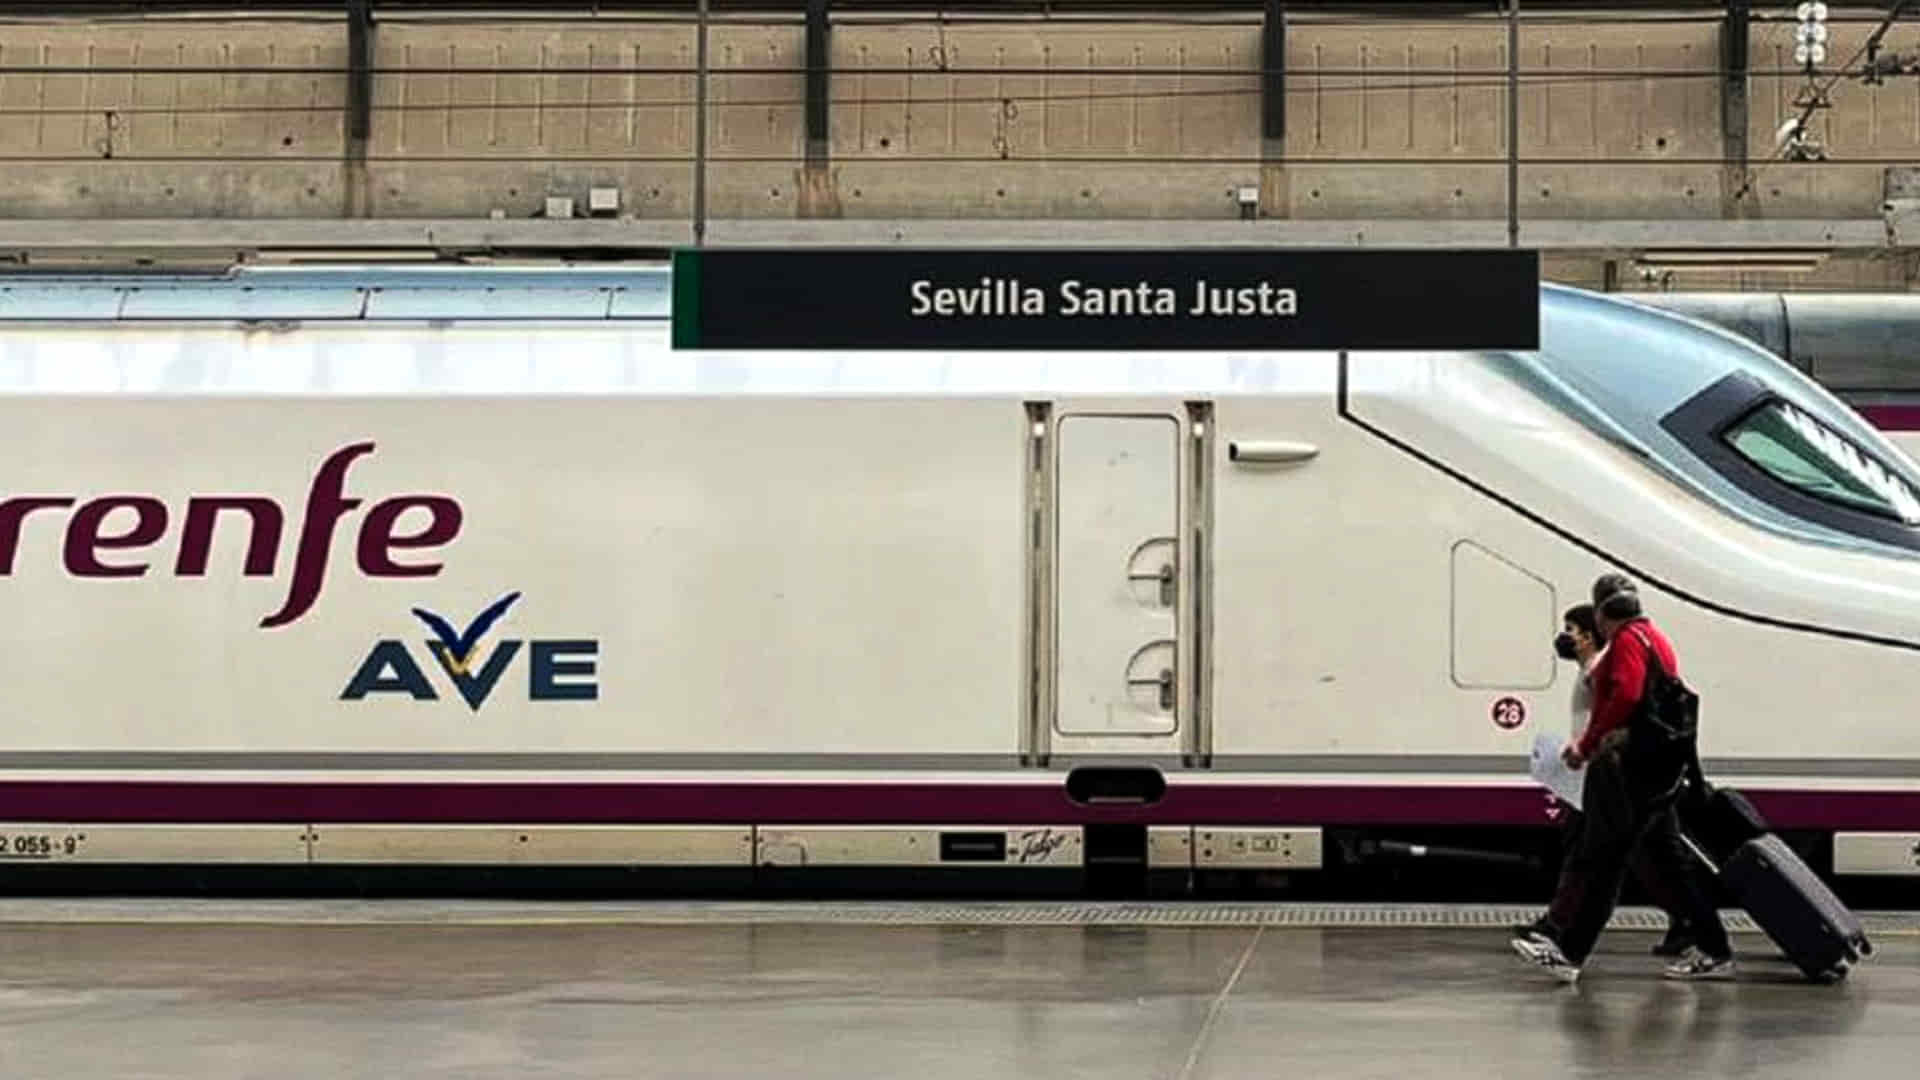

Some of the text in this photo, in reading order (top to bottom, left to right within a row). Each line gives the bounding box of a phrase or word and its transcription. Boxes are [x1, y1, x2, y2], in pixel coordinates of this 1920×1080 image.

[911, 277, 1298, 316] Sevilla Santa Justa
[0, 442, 463, 628] renfe
[339, 639, 599, 711] AVE
